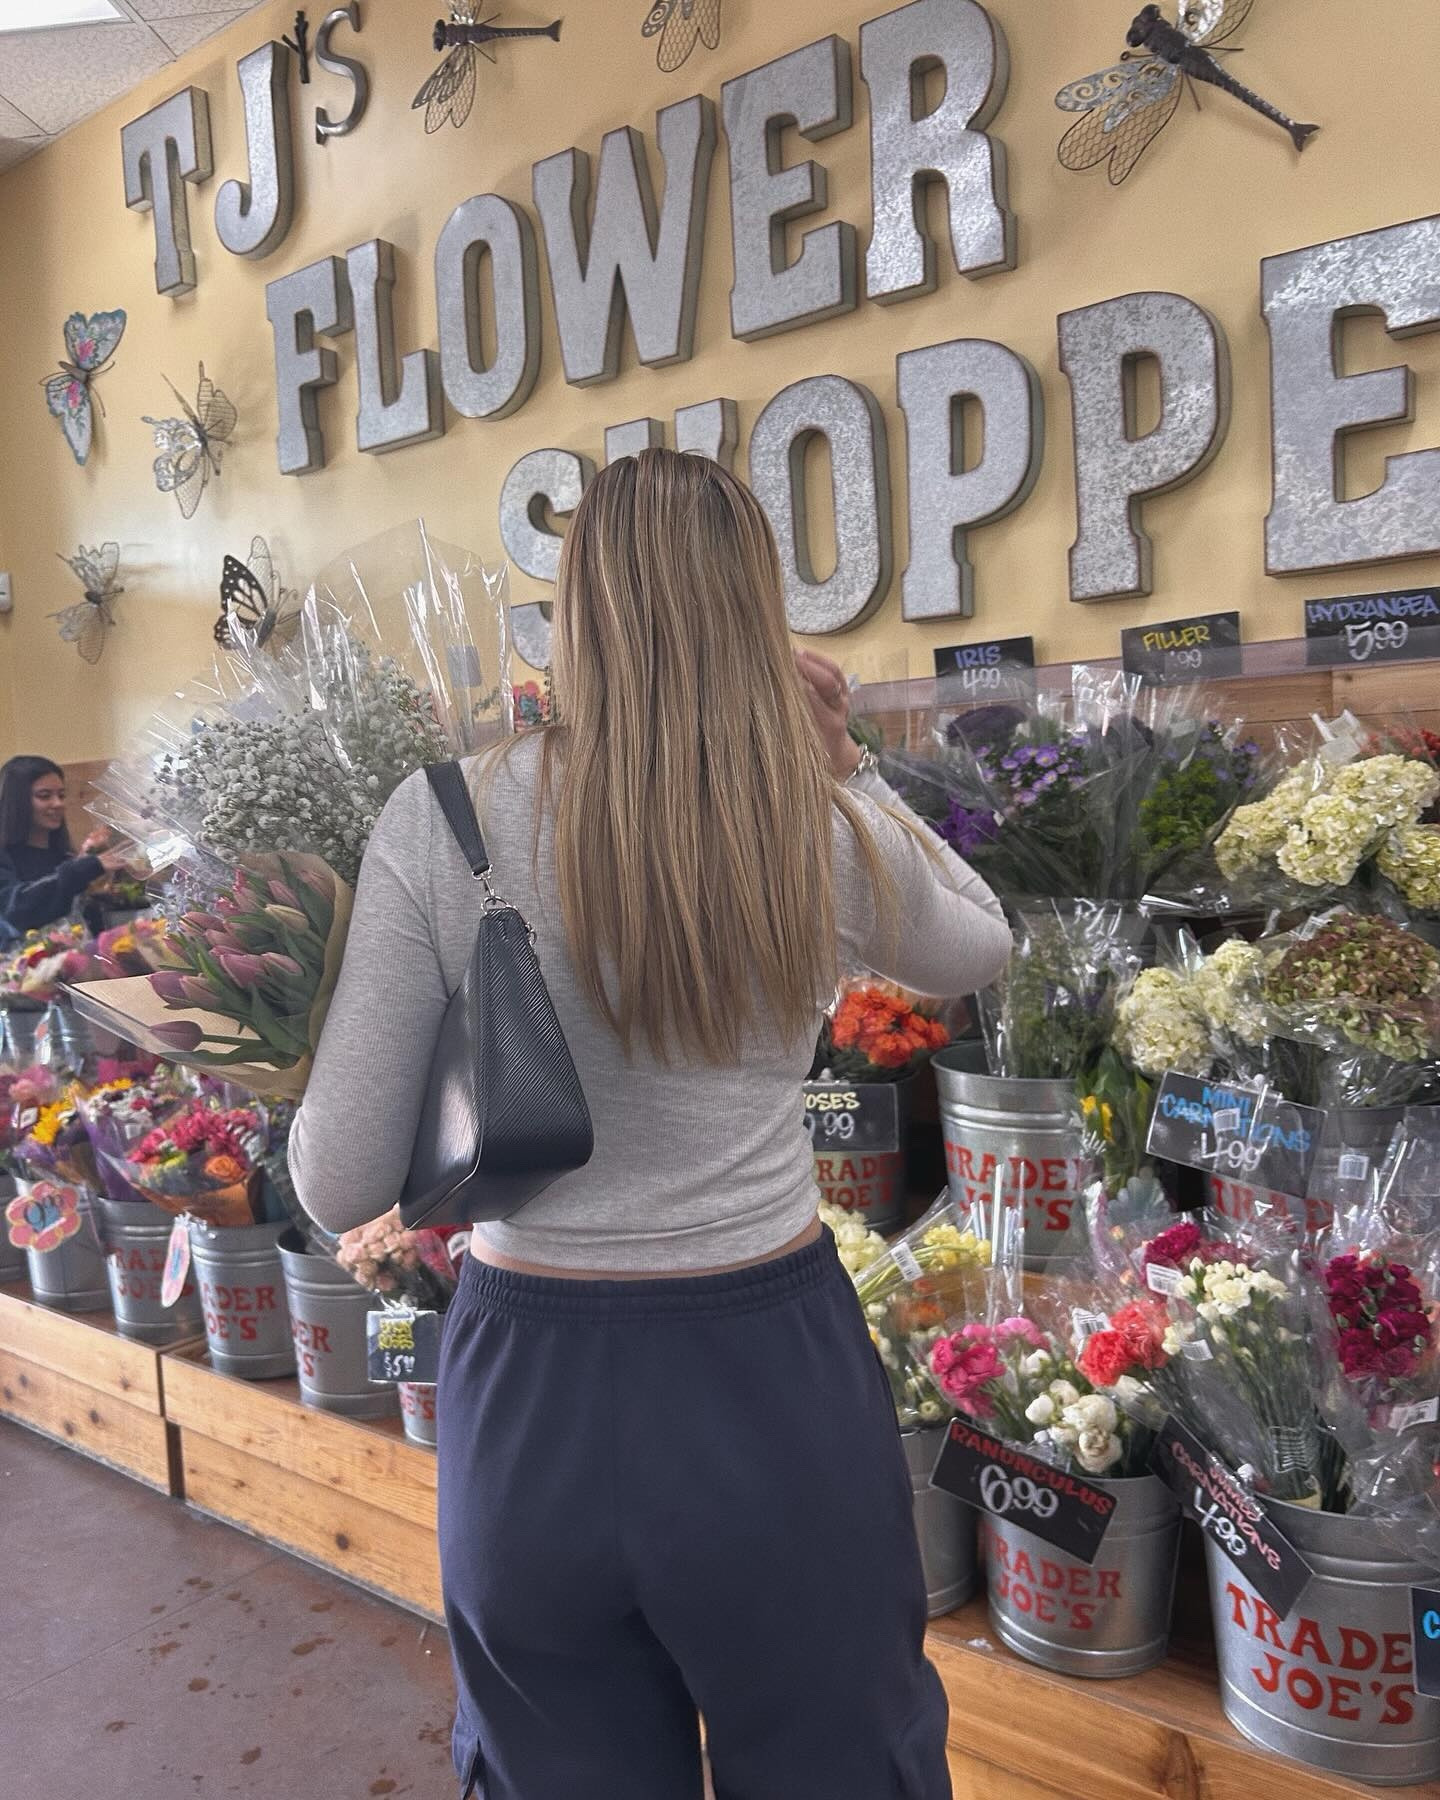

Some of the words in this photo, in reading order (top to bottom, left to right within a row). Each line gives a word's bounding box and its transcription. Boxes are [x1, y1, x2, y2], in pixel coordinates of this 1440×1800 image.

[266, 0, 1017, 476] FLOWER
[499, 212, 1440, 671] SOPPE
[1306, 594, 1440, 623] HYDRANGEA
[955, 646, 1002, 669] IRIS
[1142, 625, 1211, 652] FILLER
[803, 1092, 861, 1111] OSES
[1171, 1441, 1281, 1571] CARNATIONS
[996, 1573, 1097, 1631] JOE'S
[1251, 1651, 1416, 1725] JOE'S
